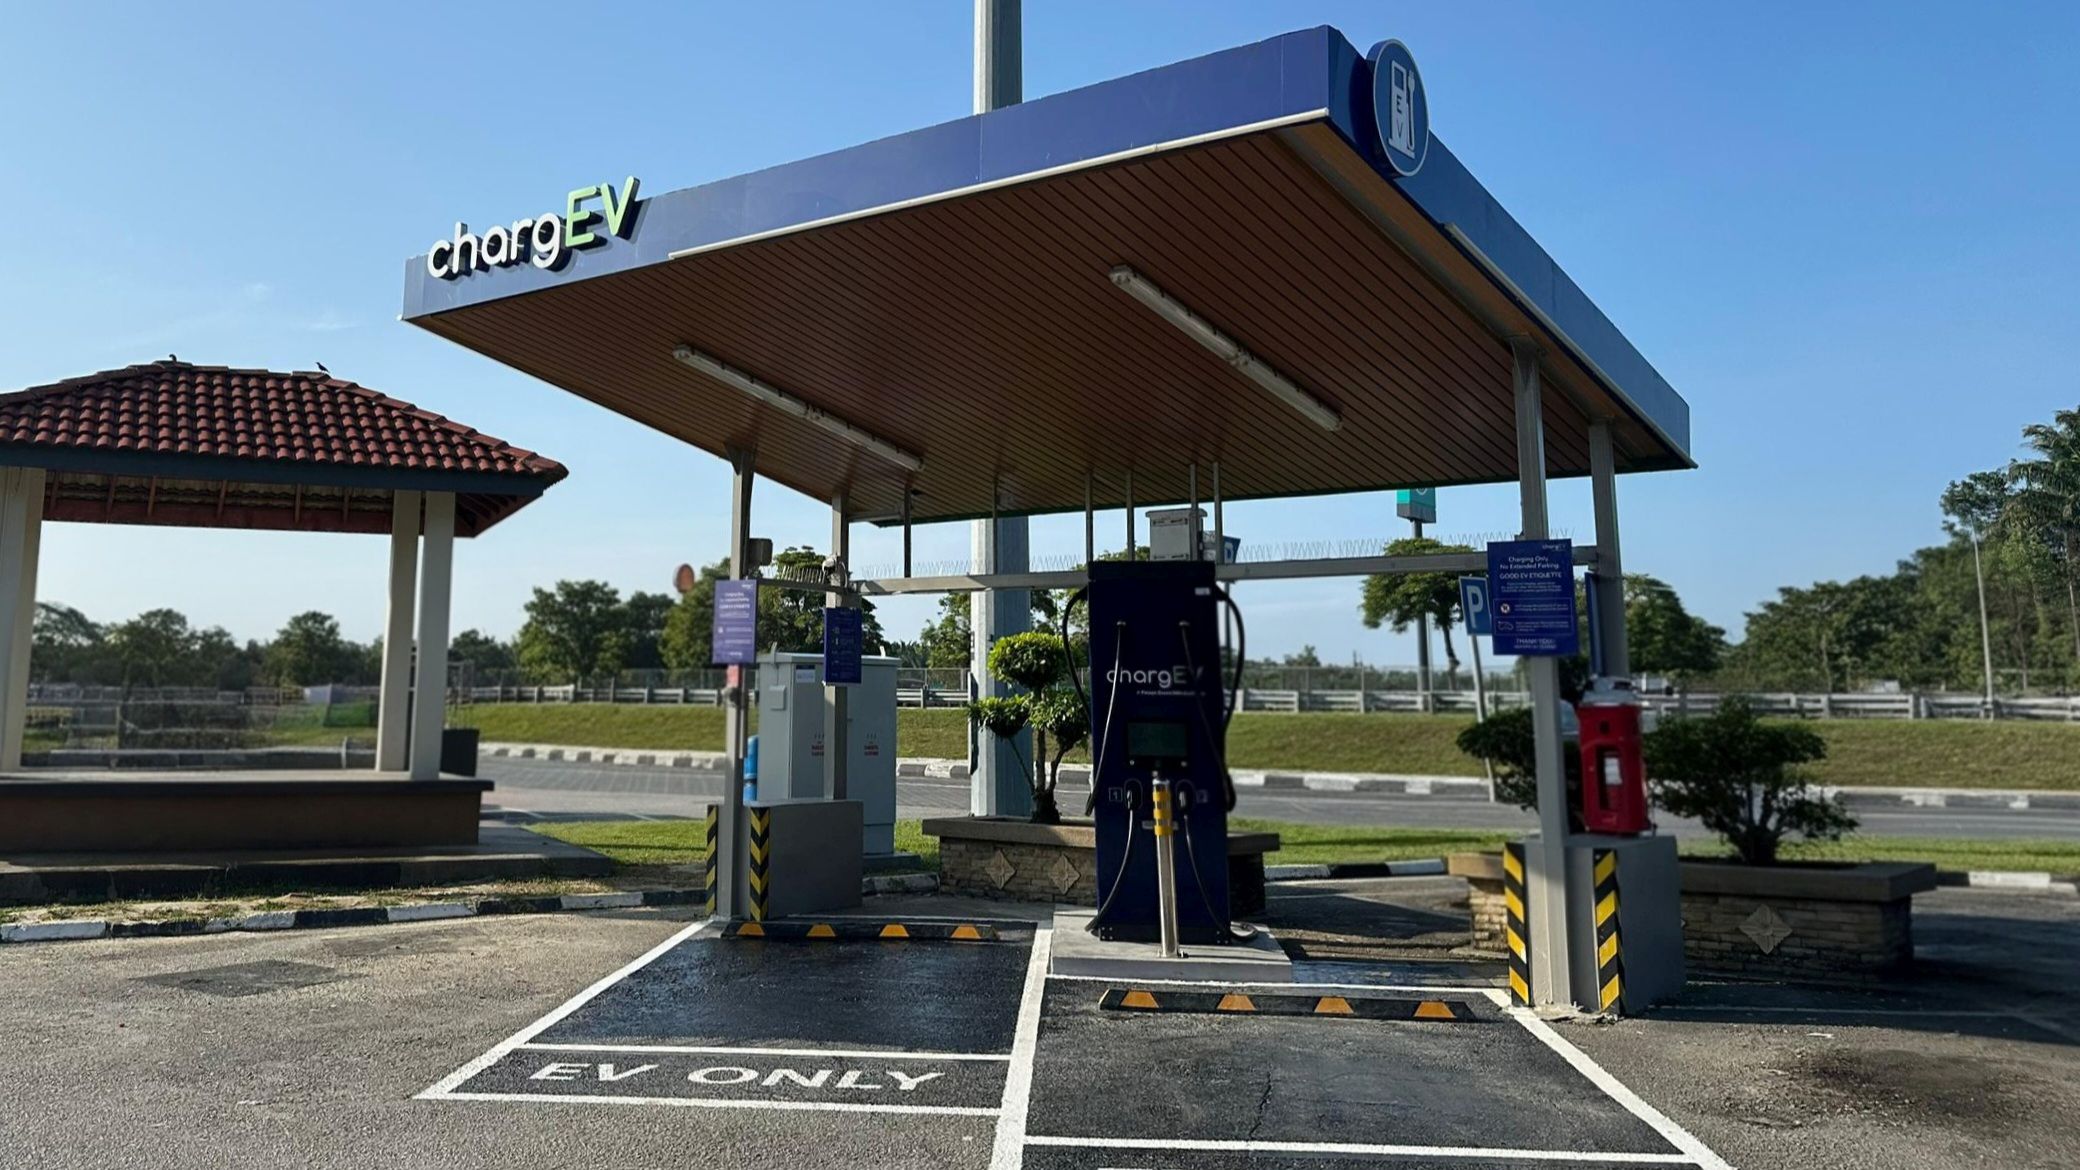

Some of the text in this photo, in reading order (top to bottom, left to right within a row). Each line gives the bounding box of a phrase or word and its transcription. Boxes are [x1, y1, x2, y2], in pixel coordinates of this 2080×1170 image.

[427, 175, 641, 279] chargEV
[1466, 585, 1483, 629] P
[530, 1062, 946, 1092] EV ONLY
